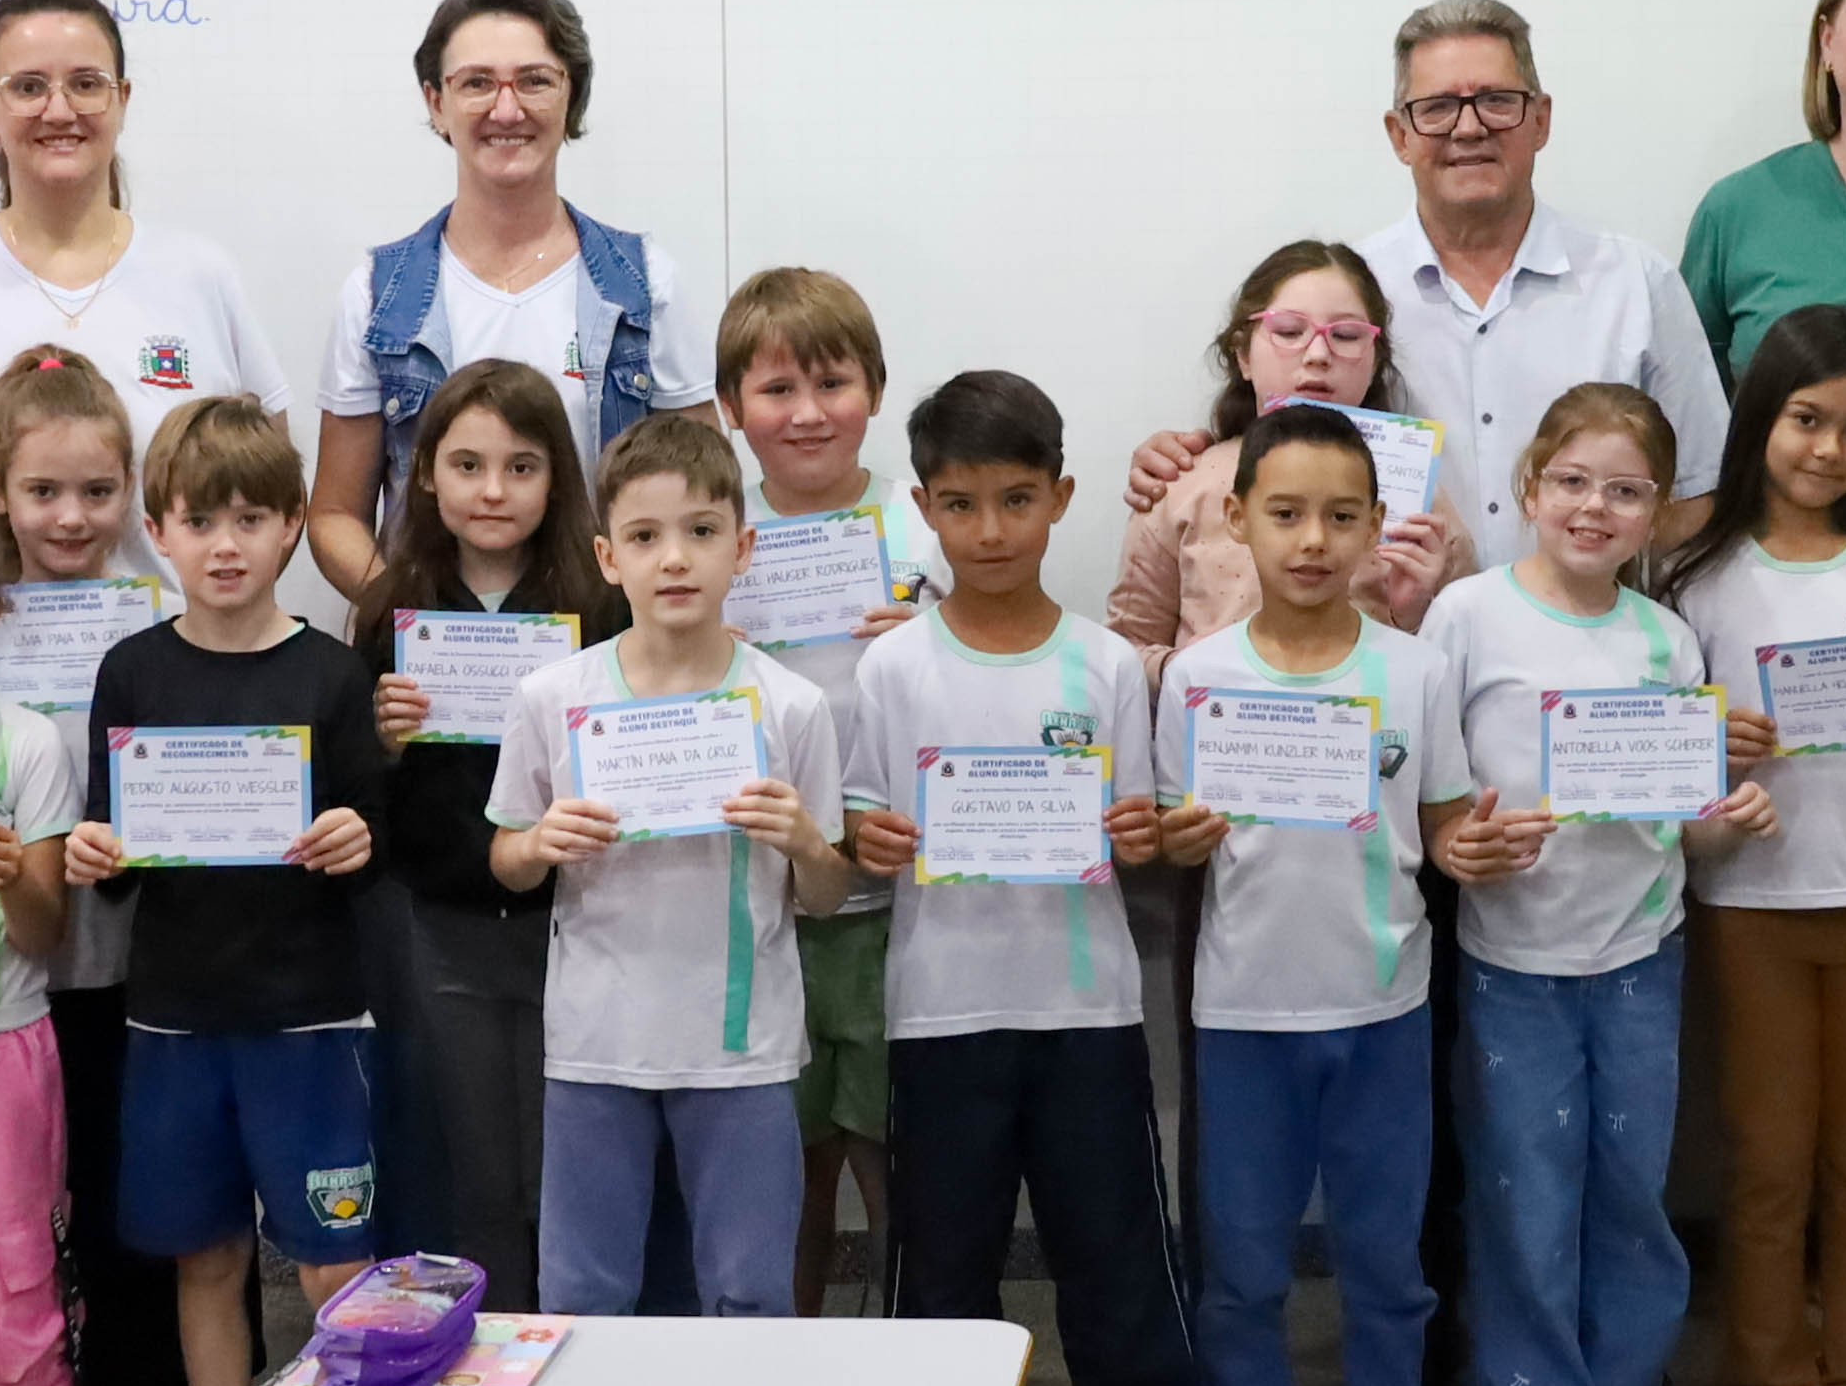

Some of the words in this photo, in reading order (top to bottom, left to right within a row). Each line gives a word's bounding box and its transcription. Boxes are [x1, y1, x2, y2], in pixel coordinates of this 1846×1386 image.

[166, 741, 227, 749] CERTIFICADO
[124, 782, 163, 795] PEDRO
[170, 781, 230, 795] AUGUSTO
[237, 780, 299, 794] WESSLER
[952, 800, 1011, 814] GUSTAVO
[1018, 800, 1034, 813] DA
[1041, 800, 1075, 813] SILVA
